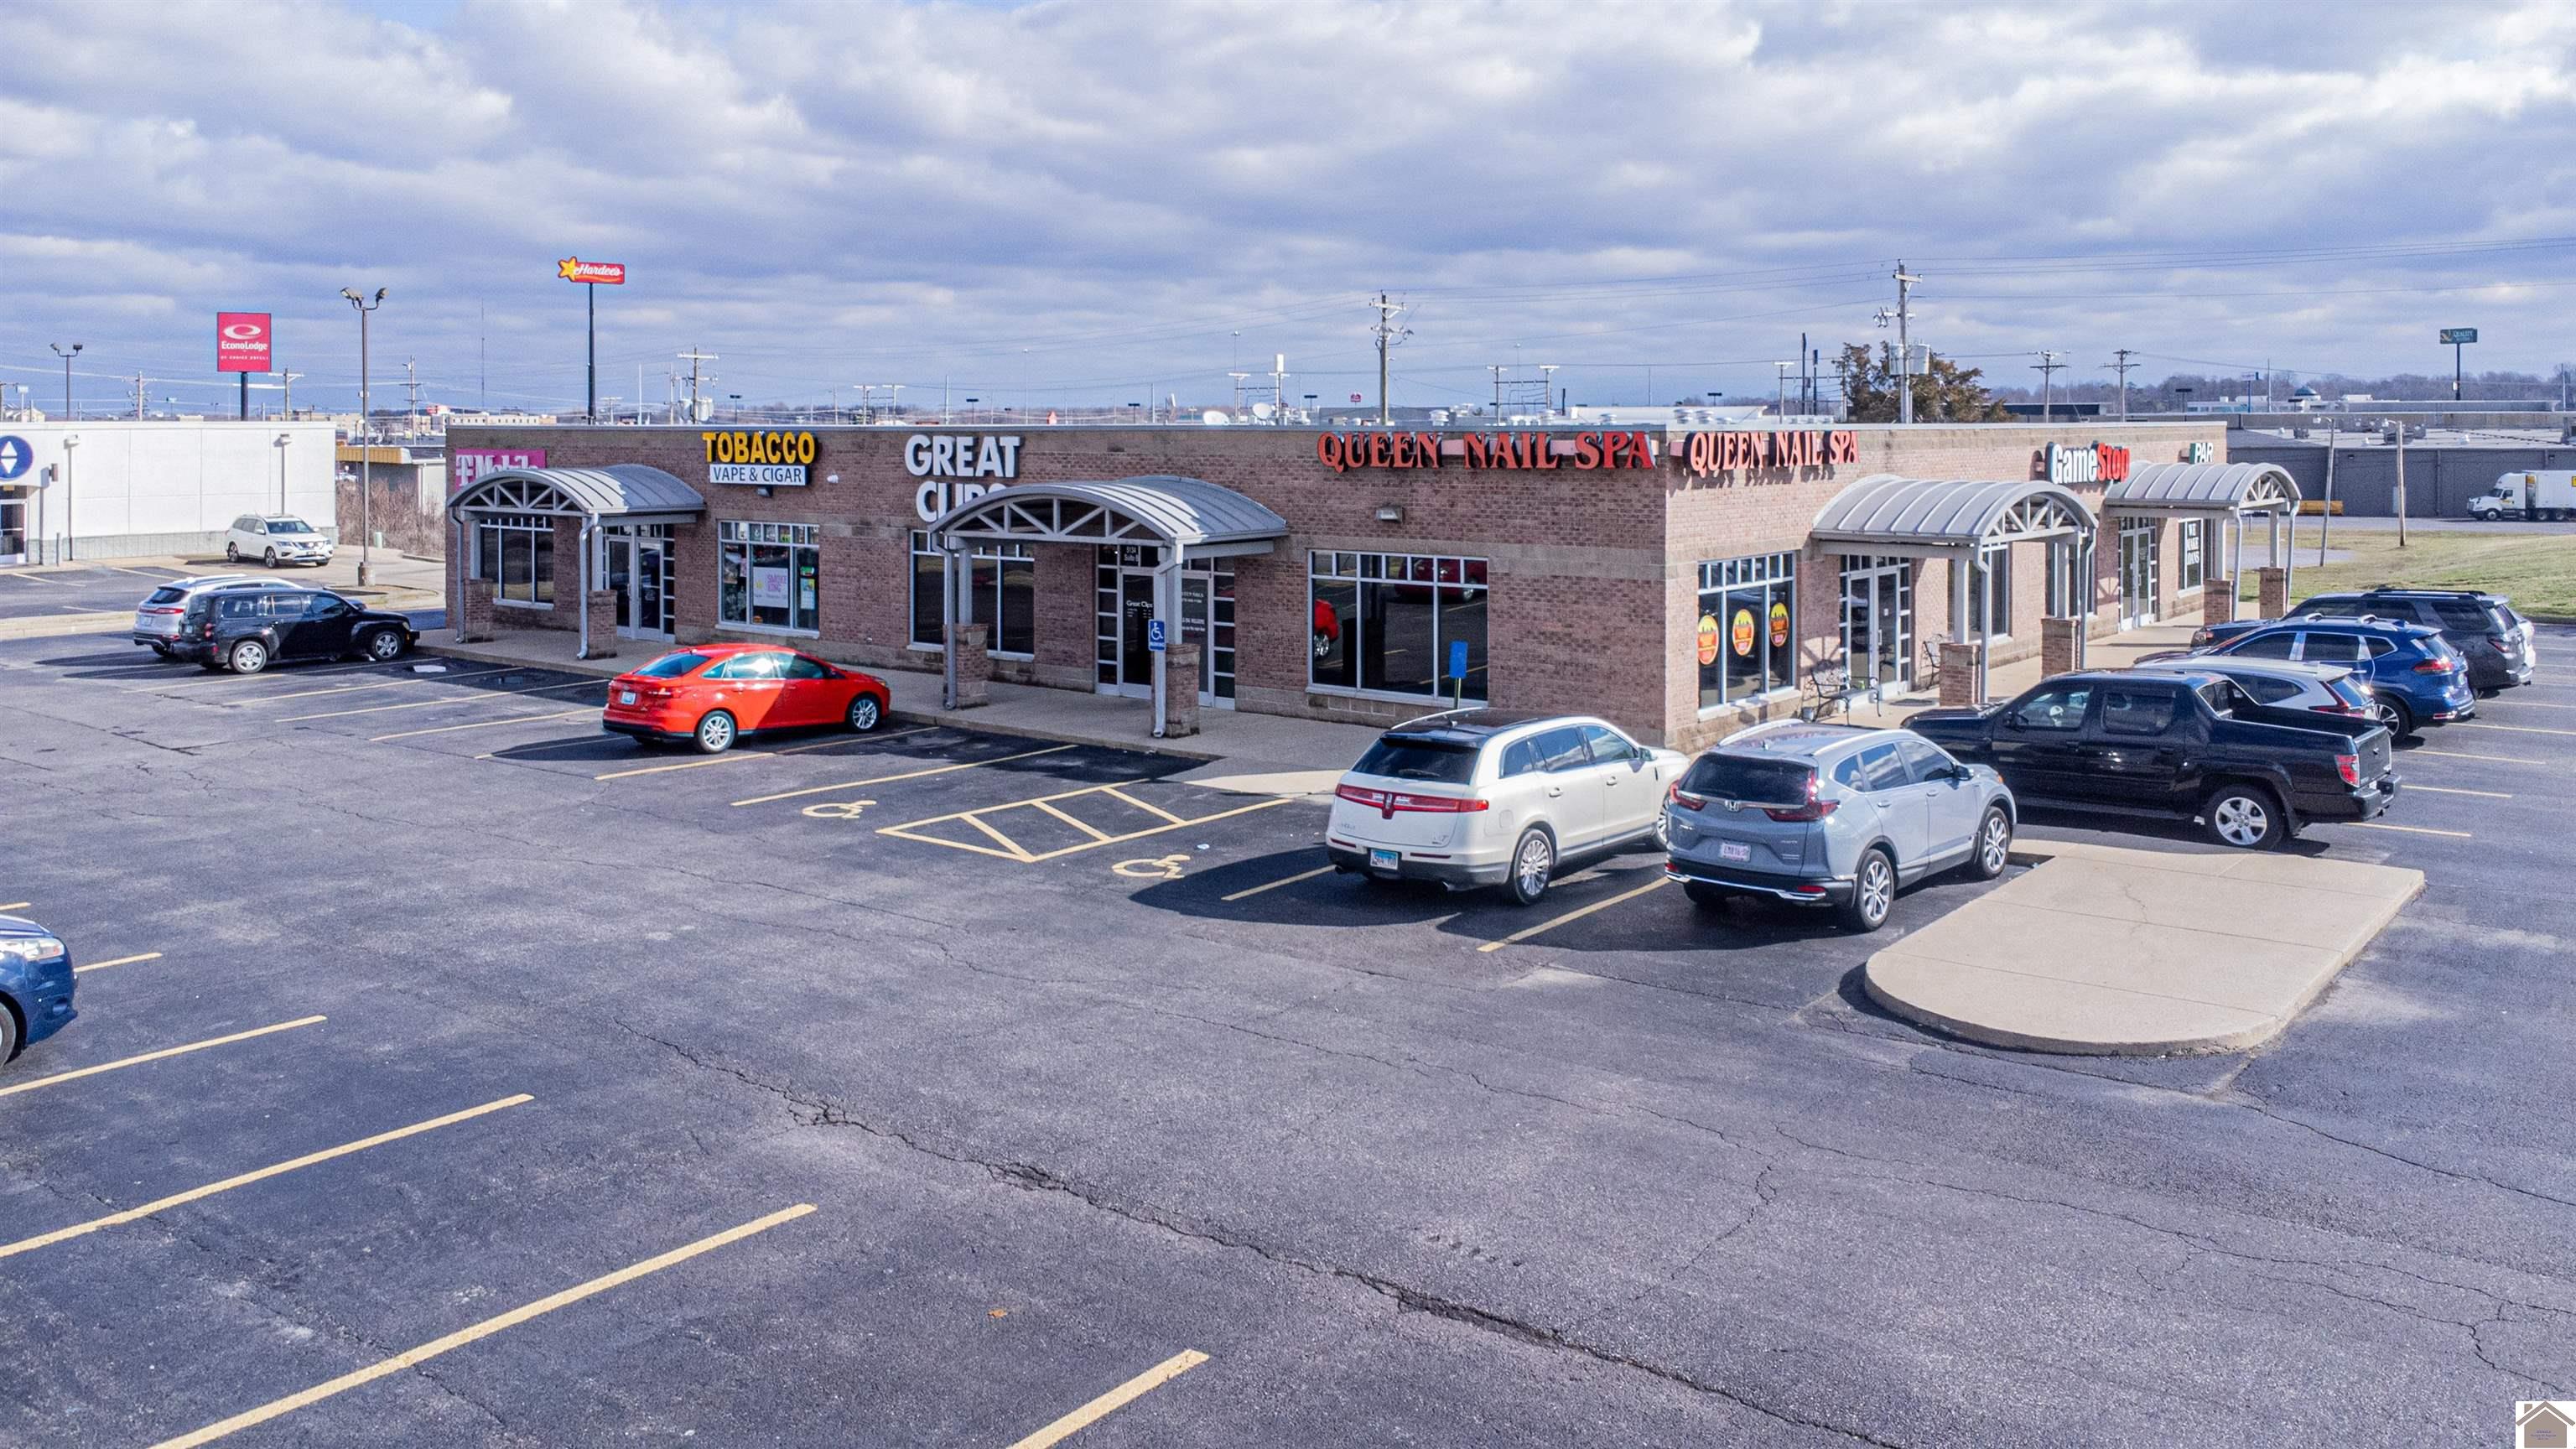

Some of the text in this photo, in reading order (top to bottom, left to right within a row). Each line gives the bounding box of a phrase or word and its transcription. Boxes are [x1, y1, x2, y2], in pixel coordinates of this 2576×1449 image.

[702, 431, 815, 464] TOBACCO
[905, 434, 1021, 478] GREAT
[1317, 431, 1656, 474] QUEEN NAIL SPA
[1690, 430, 1861, 478] QUEEN NAIL SPA
[2051, 442, 2130, 485] GameStop
[713, 466, 802, 482] VAPE & CIGAR
